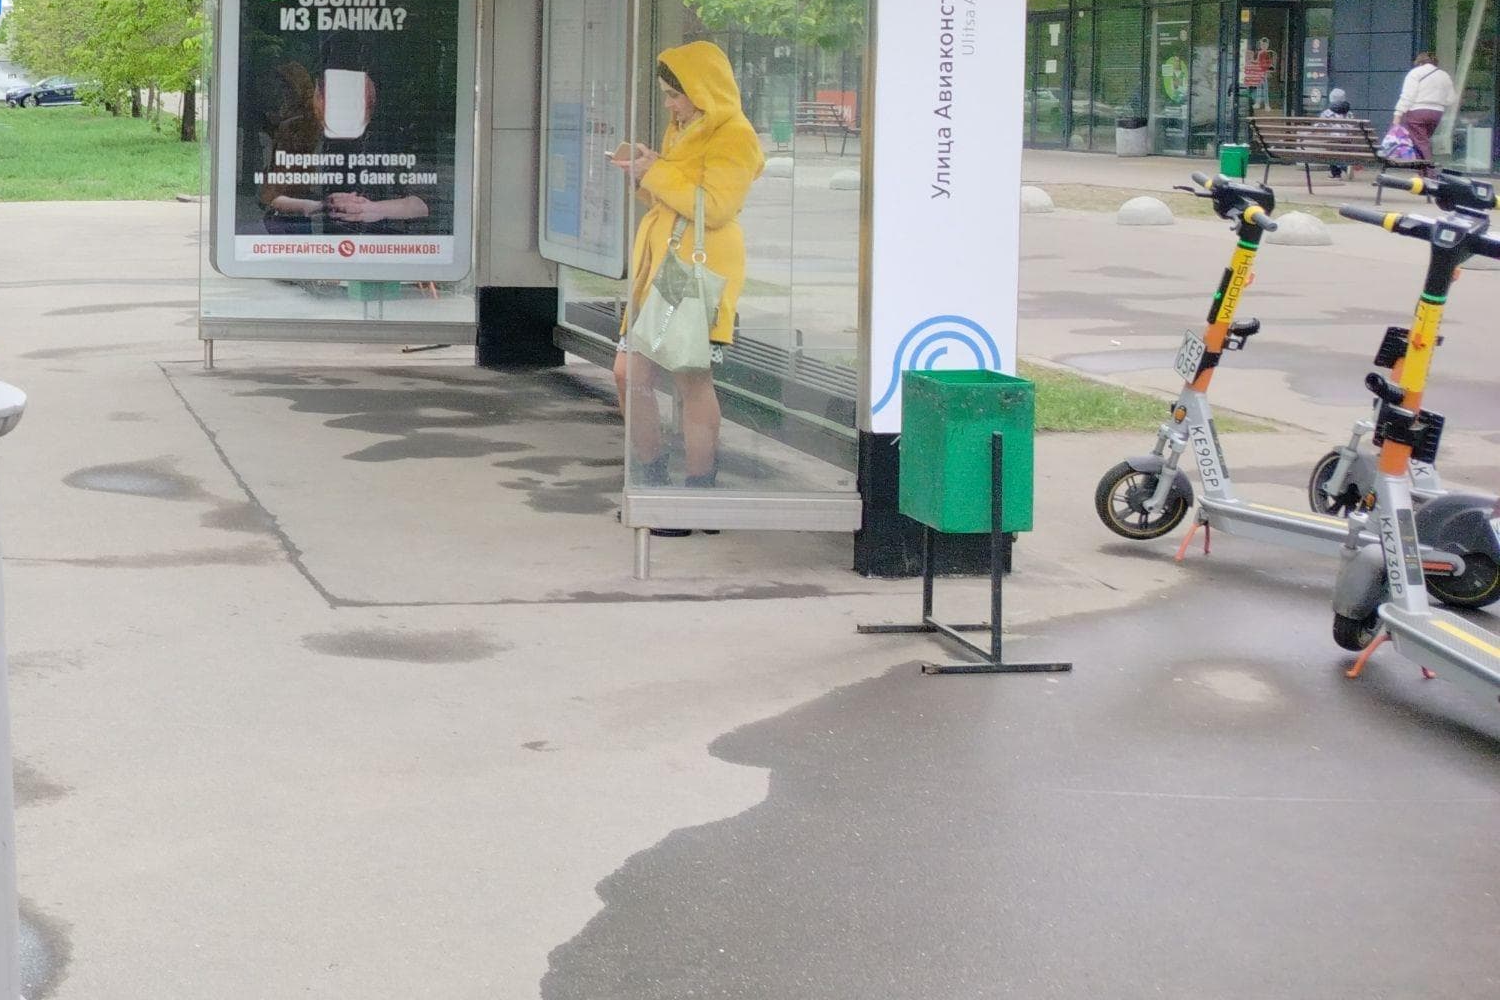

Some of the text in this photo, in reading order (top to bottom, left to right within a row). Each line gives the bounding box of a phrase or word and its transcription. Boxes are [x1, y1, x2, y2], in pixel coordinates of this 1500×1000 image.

[280, 7, 408, 31] ИЗ БАНКА?
[961, 9, 976, 56] Ulitsa
[275, 150, 417, 169] Прервите разговор
[931, 127, 955, 199] Улица
[254, 169, 438, 185] и позвоните в банк сами
[253, 242, 441, 255] ОСТЕРЕГАЙТЕСЬ МОШЕННИКОВ!
[1220, 254, 1253, 320] WHOOSH
